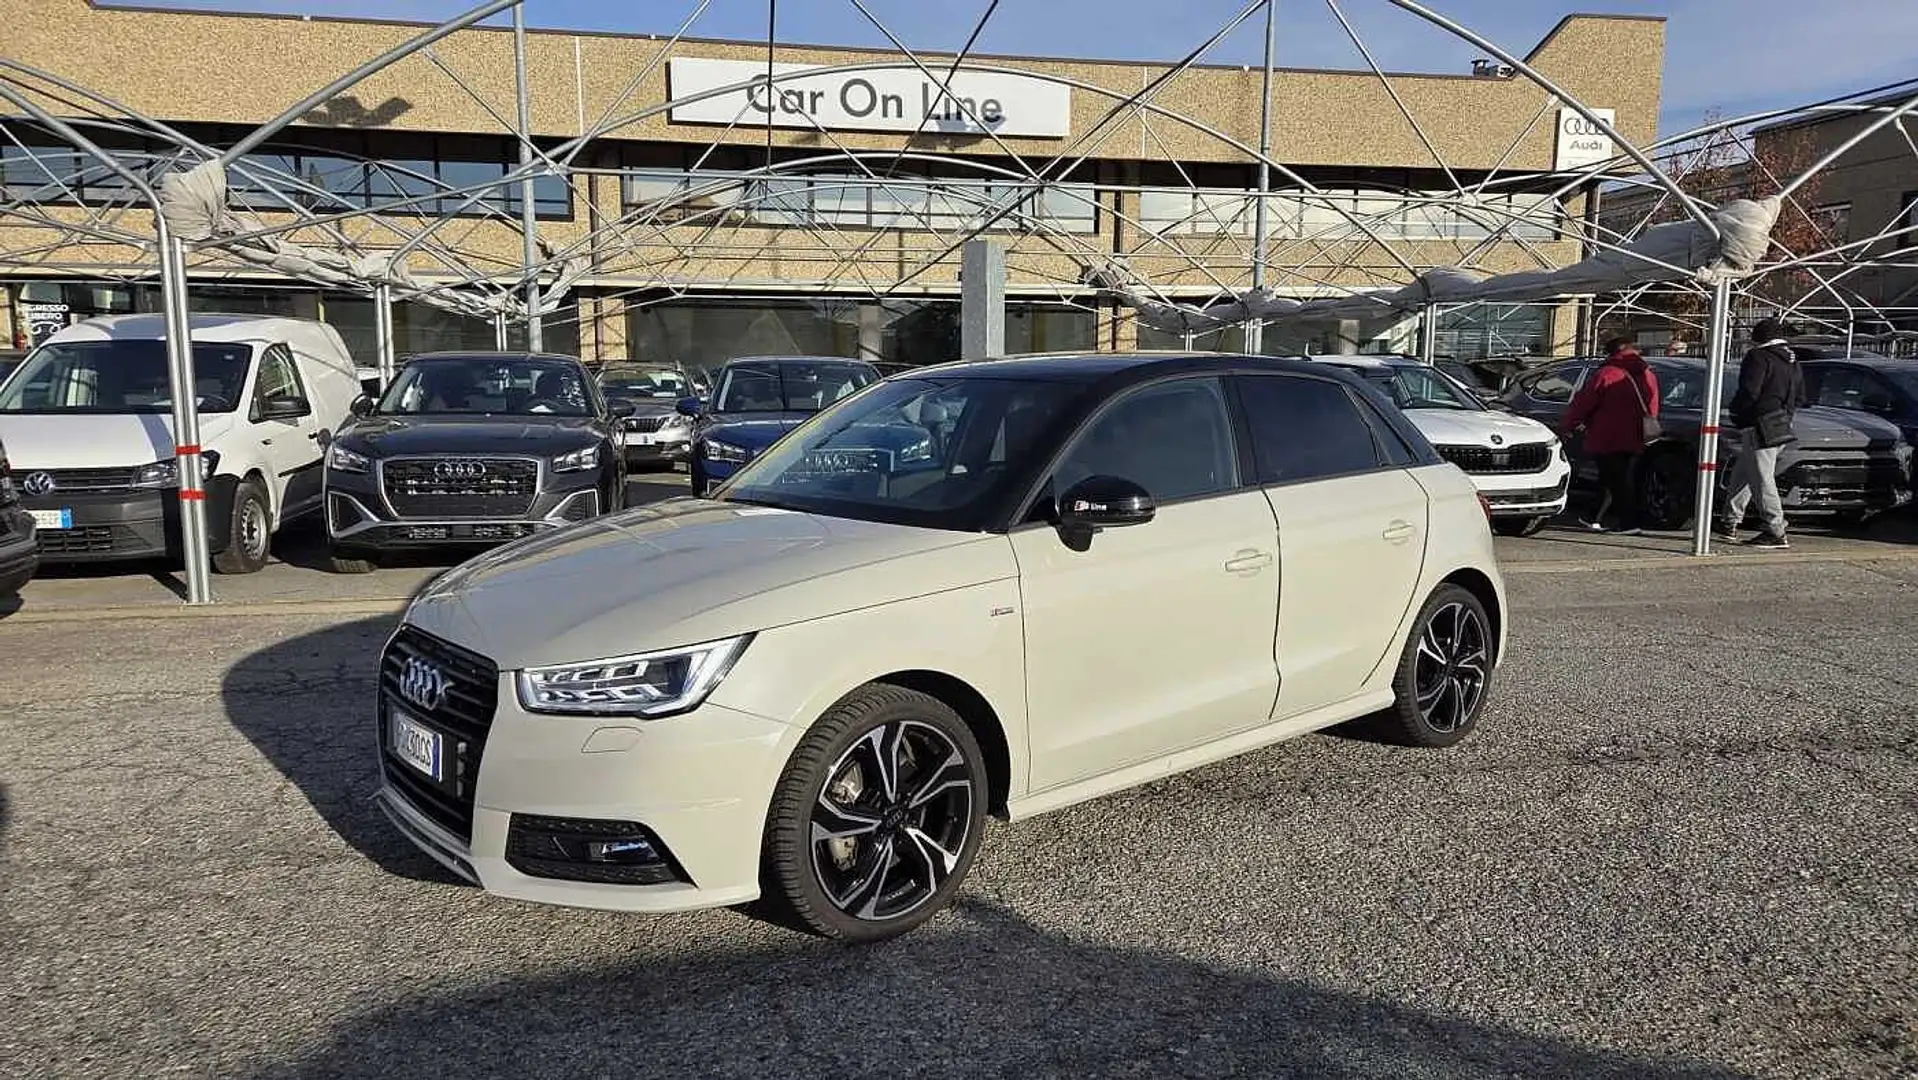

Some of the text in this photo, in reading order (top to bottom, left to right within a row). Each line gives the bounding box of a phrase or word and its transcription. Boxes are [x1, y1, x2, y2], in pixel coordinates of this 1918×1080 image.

[747, 74, 1002, 123] Car On Line
[1569, 140, 1603, 151] Audi
